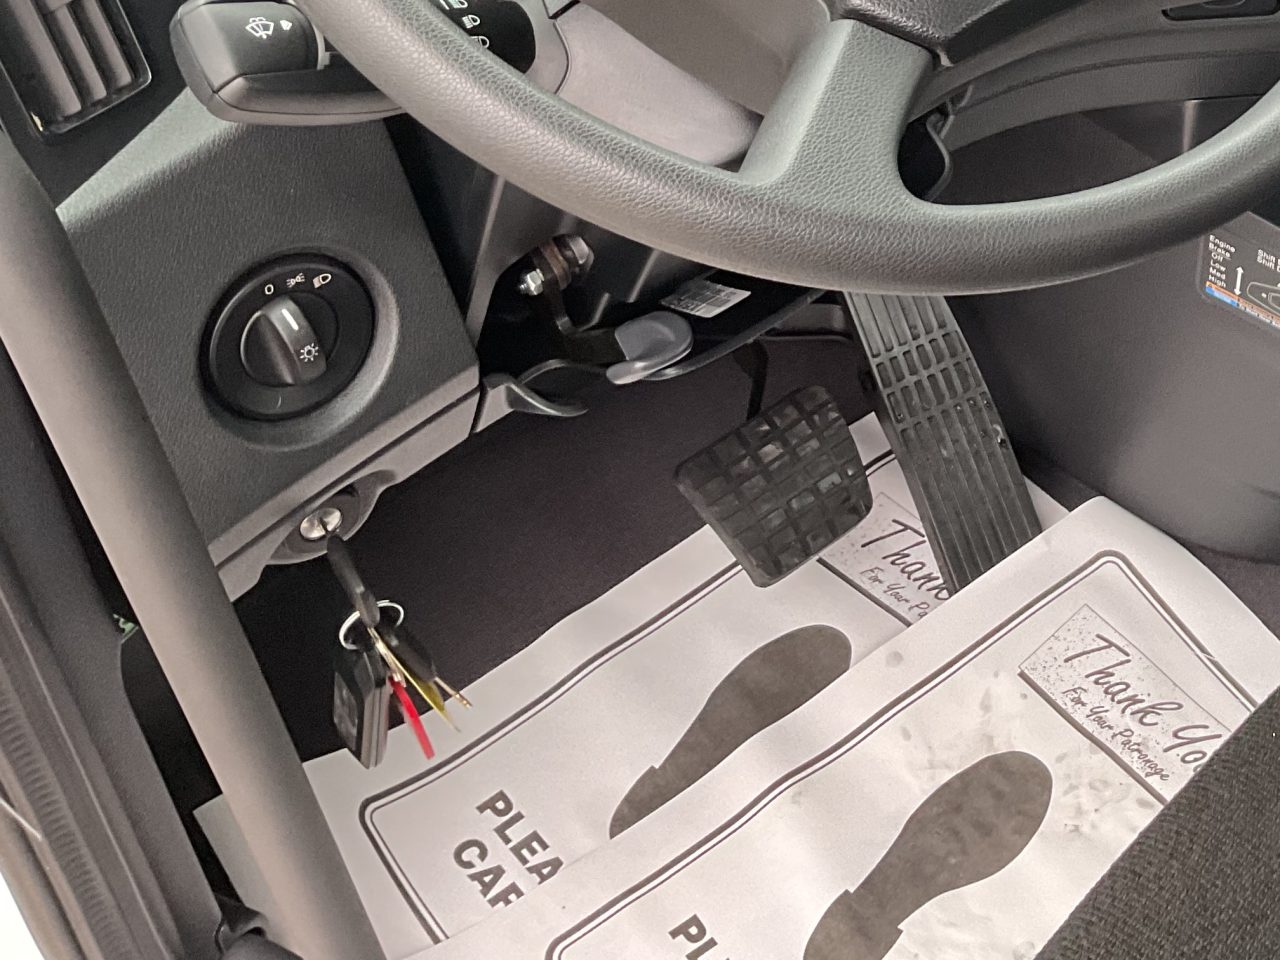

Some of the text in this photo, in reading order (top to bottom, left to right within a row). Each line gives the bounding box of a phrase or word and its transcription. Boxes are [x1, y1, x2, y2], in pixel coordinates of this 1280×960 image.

[1209, 243, 1231, 258] Brake
[1210, 235, 1236, 253] Engine
[1211, 252, 1223, 262] Off
[1257, 255, 1275, 270] Shift
[1258, 249, 1276, 264] Shift
[1210, 260, 1226, 271] Low
[1210, 267, 1226, 280] Med
[1209, 275, 1226, 288] High
[860, 567, 884, 584] For
[883, 583, 910, 603] Your
[1064, 633, 1223, 773] Thank Yo
[1062, 686, 1170, 781] For Your Patronage
